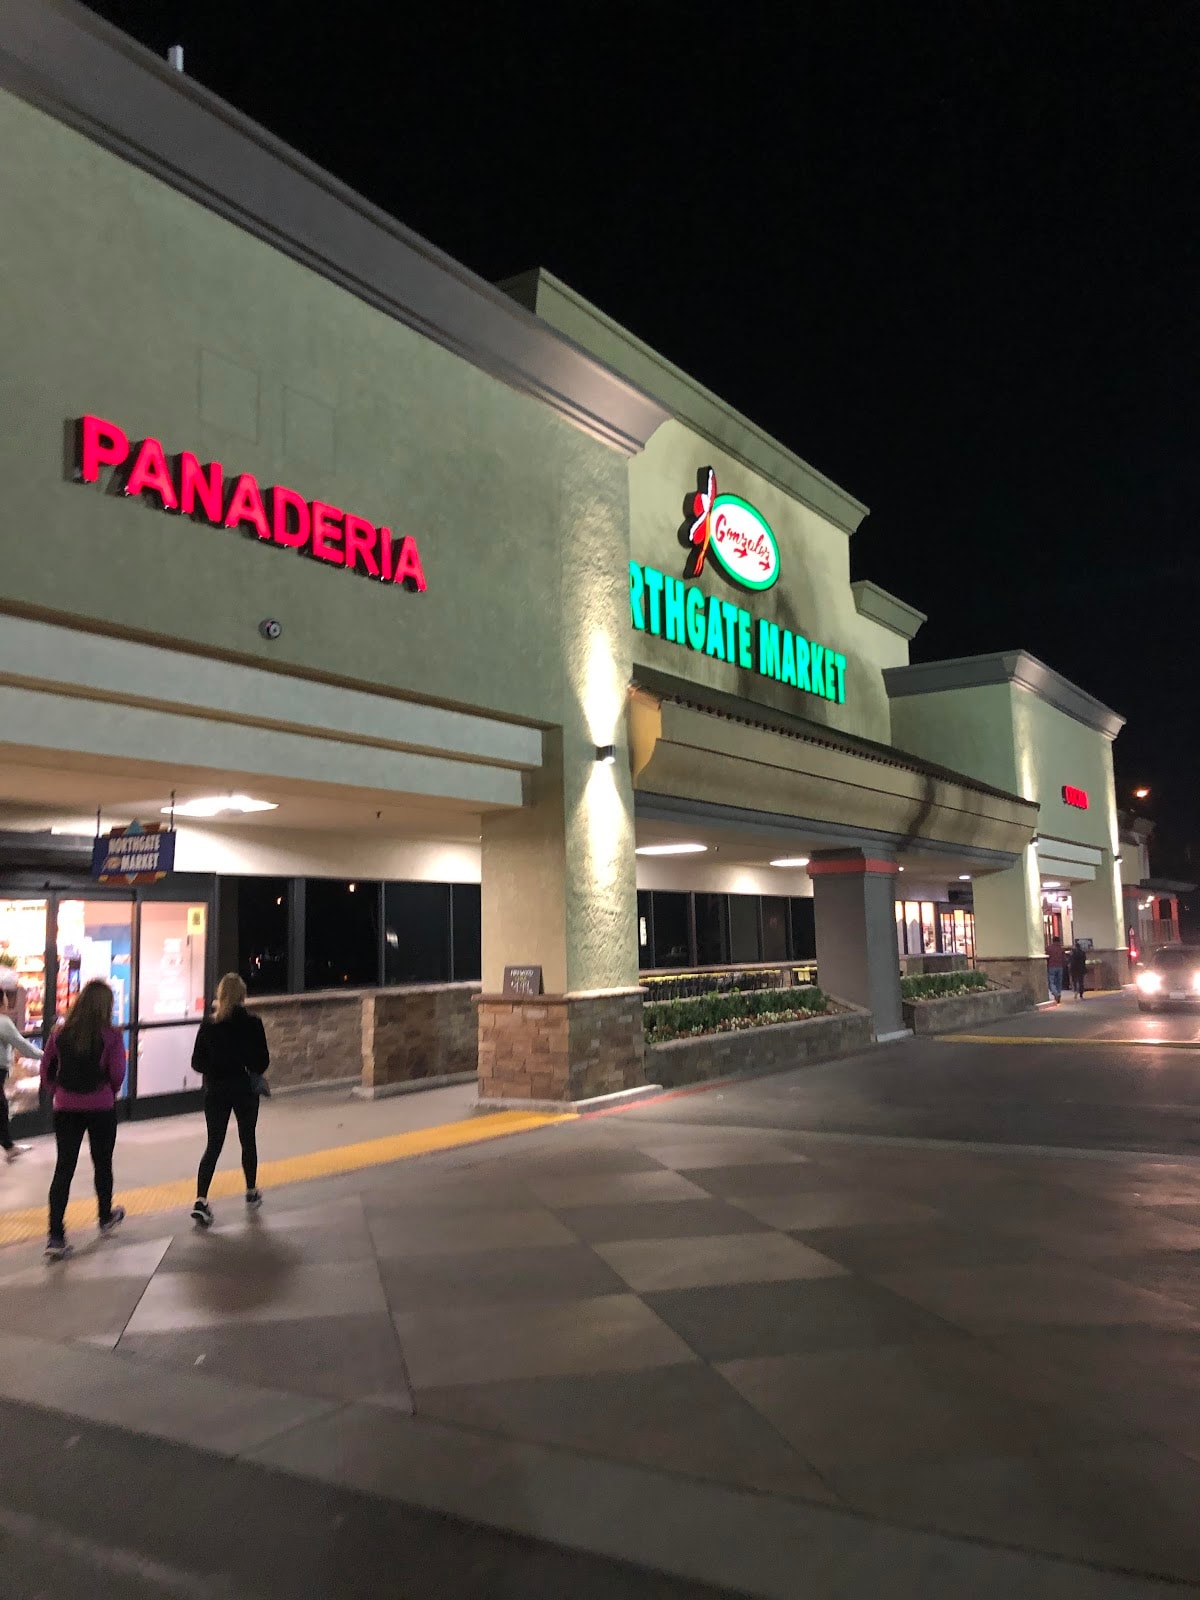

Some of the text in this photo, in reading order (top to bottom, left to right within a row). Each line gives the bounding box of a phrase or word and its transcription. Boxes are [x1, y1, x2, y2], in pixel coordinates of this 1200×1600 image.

[82, 414, 427, 592] PANADERIA
[759, 618, 847, 704] MARKET
[120, 852, 159, 872] MARKET
